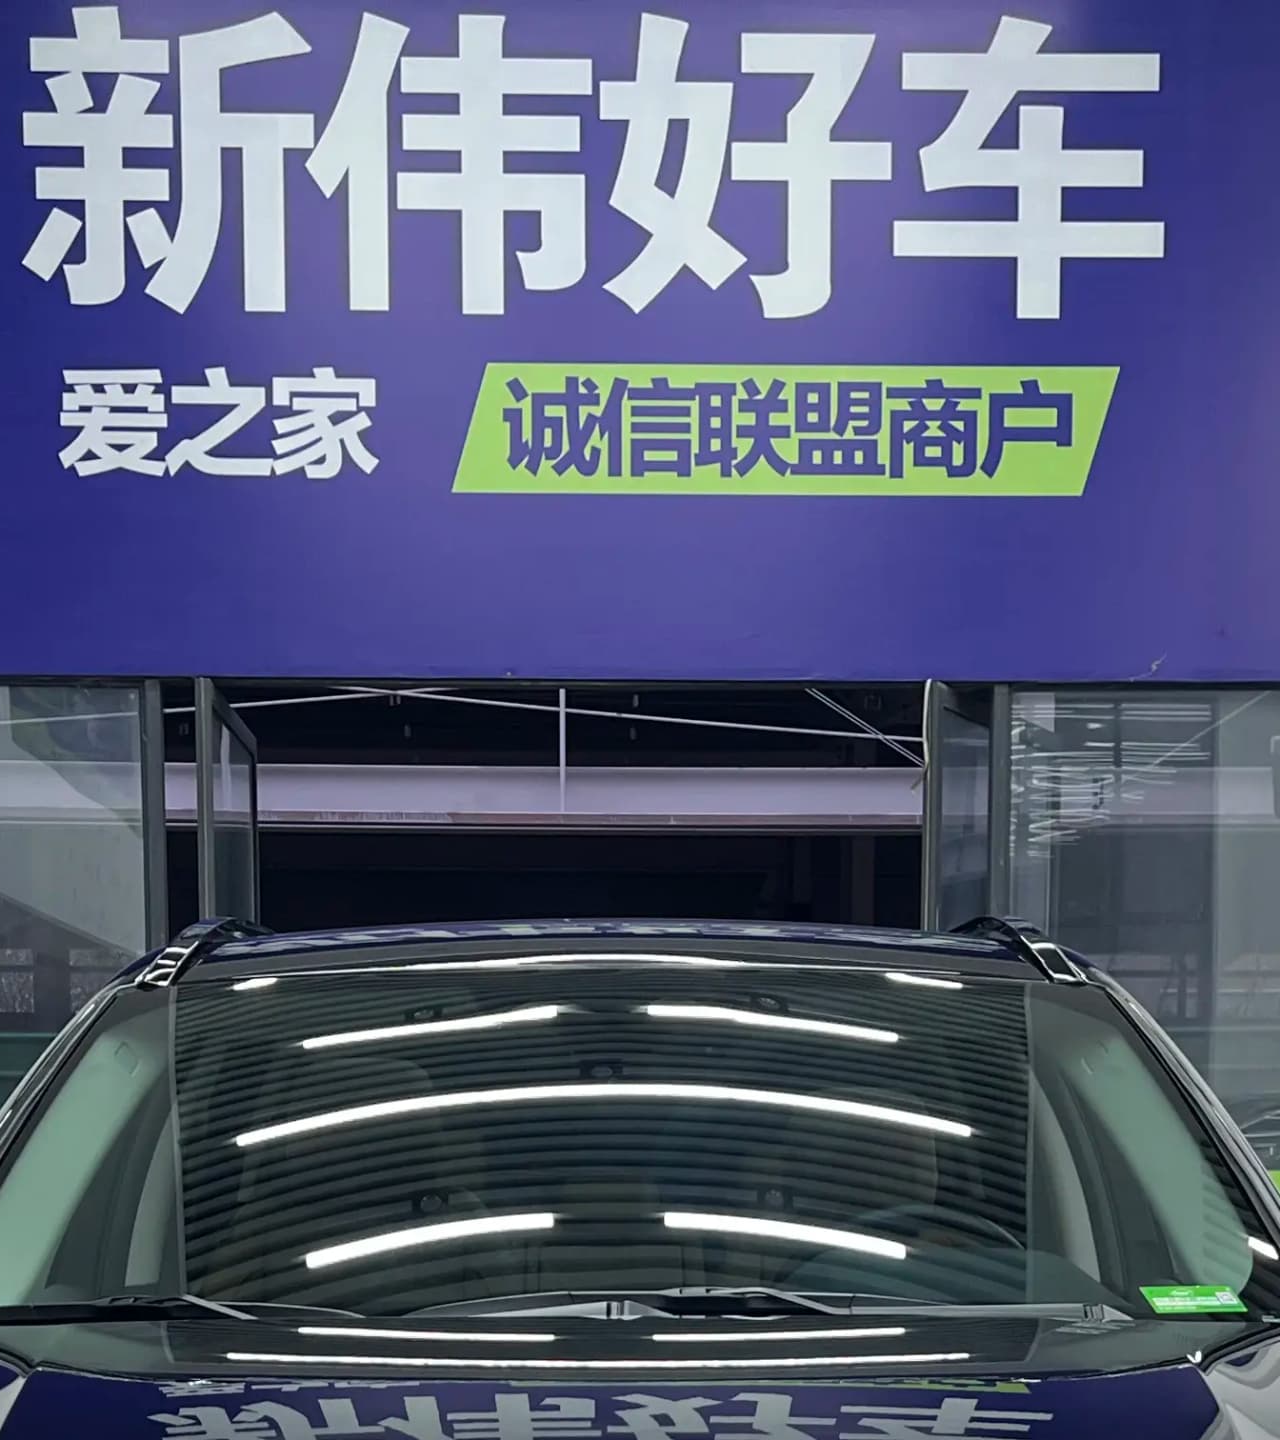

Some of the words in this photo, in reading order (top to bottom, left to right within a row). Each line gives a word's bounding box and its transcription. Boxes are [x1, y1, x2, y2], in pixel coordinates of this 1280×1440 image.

[22, 6, 1166, 319] 新伟好车
[58, 367, 380, 479] 爱之家
[503, 376, 1074, 479] 诚信联盟商户
